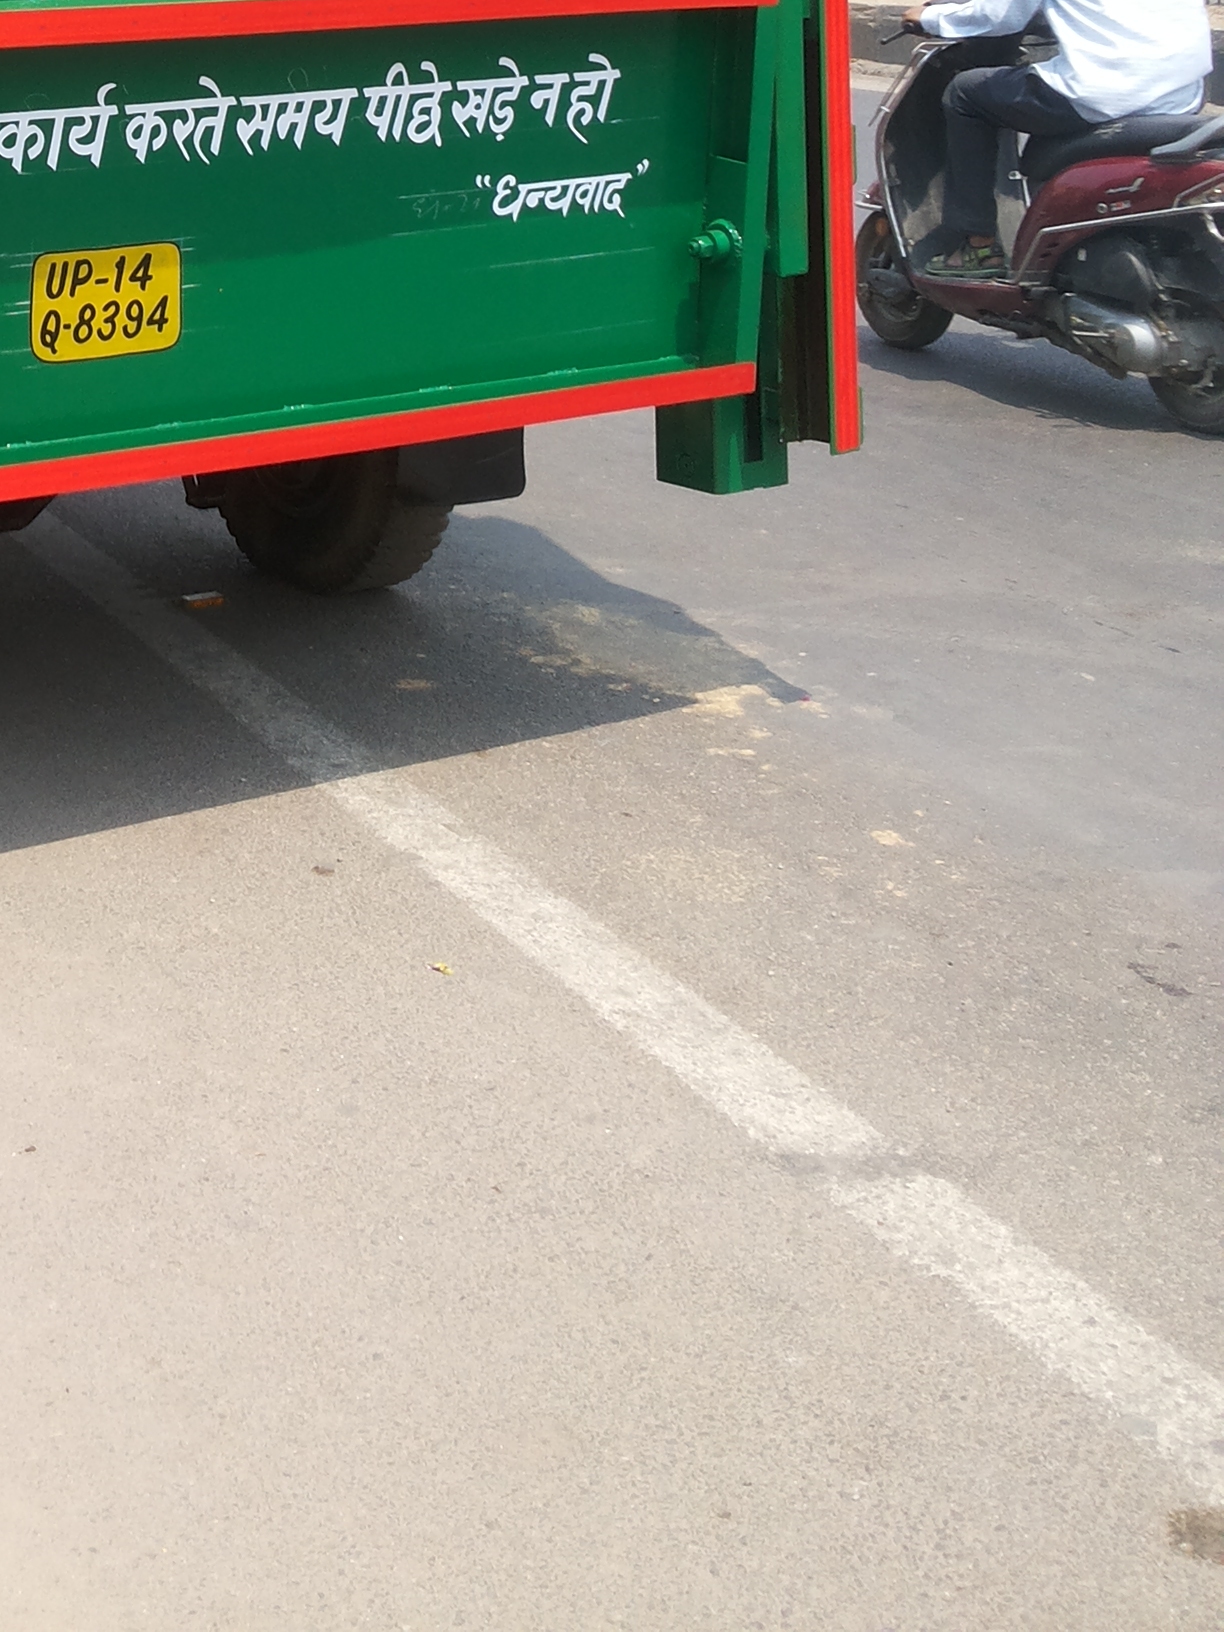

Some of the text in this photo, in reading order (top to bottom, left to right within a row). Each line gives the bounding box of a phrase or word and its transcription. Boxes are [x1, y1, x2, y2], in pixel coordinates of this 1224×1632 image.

[125, 76, 237, 164] करते
[236, 88, 358, 155] समय
[363, 62, 452, 146] पीछे
[452, 57, 529, 141] खड़े
[531, 73, 571, 127] न
[567, 54, 621, 143] हो
[45, 253, 153, 299] UP-14
[39, 295, 169, 355] Q-8394
